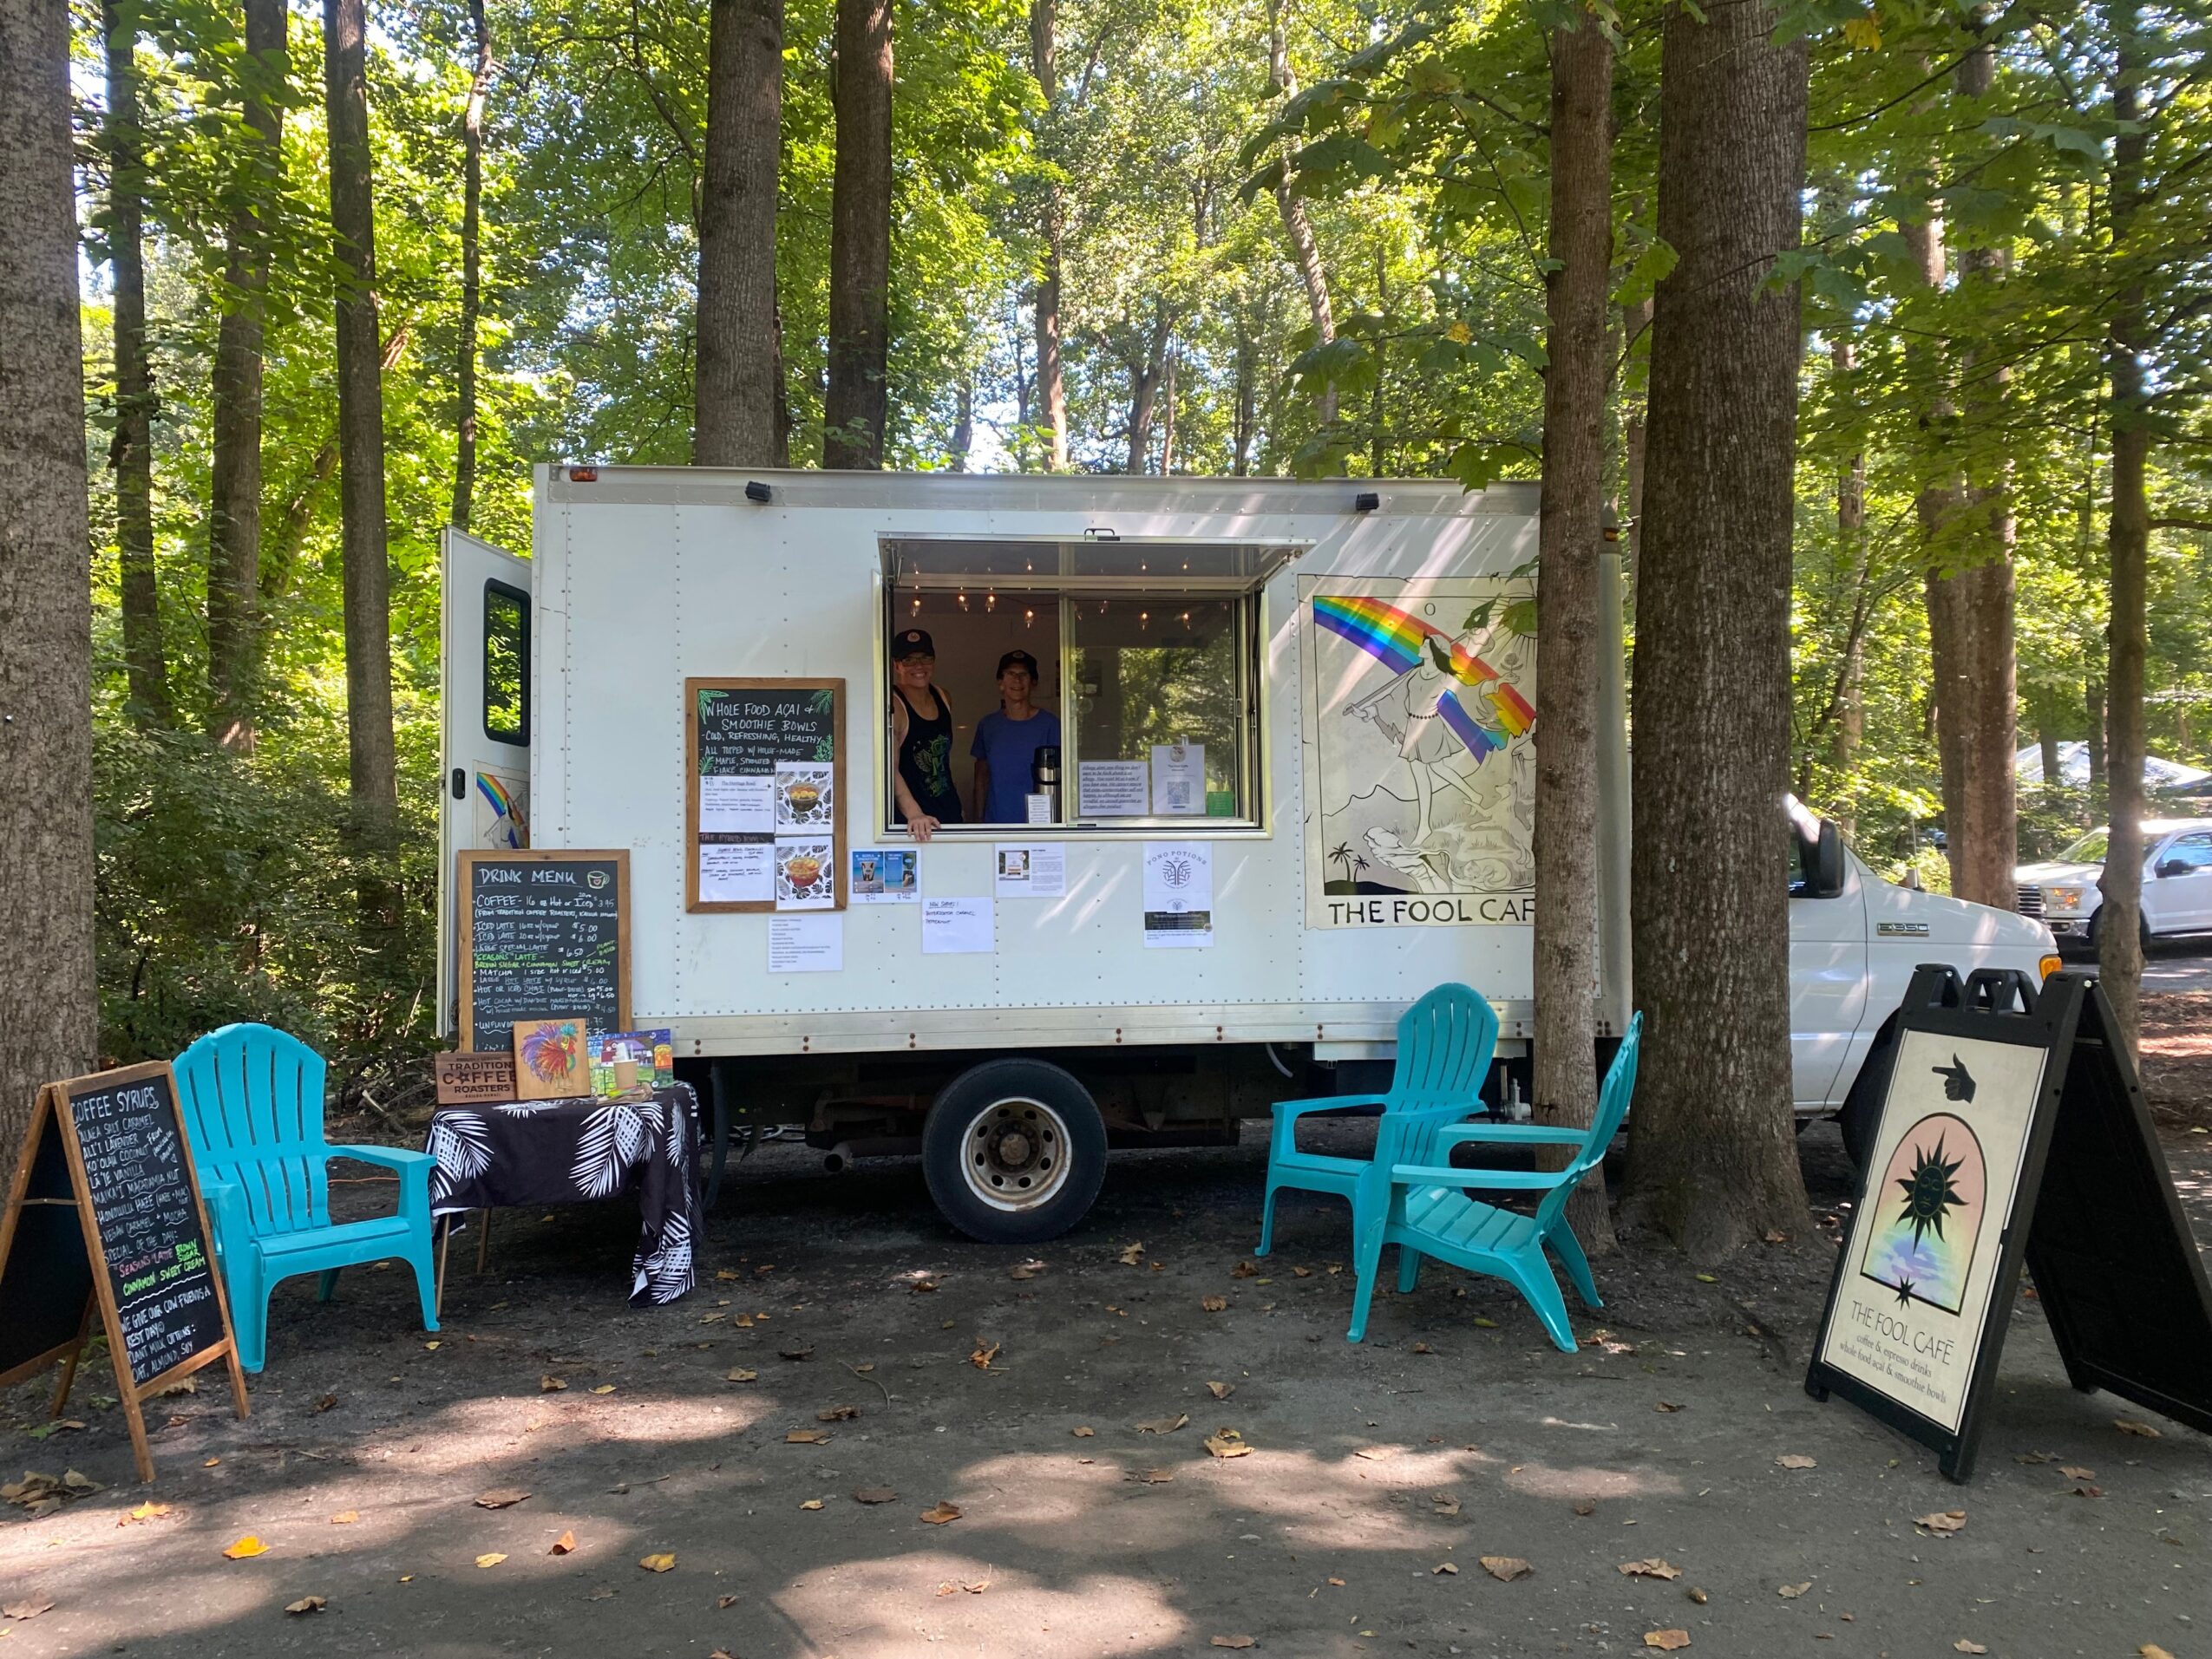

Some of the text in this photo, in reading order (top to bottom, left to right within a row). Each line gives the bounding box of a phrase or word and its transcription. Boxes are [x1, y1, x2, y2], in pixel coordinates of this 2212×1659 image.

[705, 702, 739, 716] WHOLE
[745, 703, 770, 716] FOOD
[722, 718, 817, 732] SMOOTHIE BOWLS
[784, 734, 822, 744] HEALTHY
[1147, 852, 1168, 865] PONO
[1171, 851, 1207, 865] POTIONS
[479, 868, 577, 884] DRINK MENU
[527, 895, 535, 906] 16
[550, 896, 561, 906] Hot
[1328, 898, 1535, 924] THE FOOL CAF
[476, 922, 494, 931] ICED
[496, 922, 515, 931] LATTE
[477, 932, 495, 942] ICED
[448, 1061, 513, 1070] TRADITION
[455, 1084, 510, 1094] ROASTERS
[70, 1087, 154, 1124] COFFEE SYRUPS
[122, 1114, 154, 1131] CARAMEL
[104, 1133, 138, 1152] LAVENDER
[114, 1164, 145, 1181] VANILLA
[167, 1168, 179, 1183] NUT
[126, 1217, 154, 1232] CARAMEL
[163, 1208, 187, 1222] MOCHA
[104, 1244, 133, 1265] SPECIAL
[136, 1238, 144, 1250] OF
[146, 1235, 157, 1247] THE
[123, 1257, 206, 1296] CINNAMON SWEET CREAM
[120, 1316, 132, 1333] WE
[132, 1309, 148, 1329] GIVE
[148, 1305, 162, 1319] OUR
[163, 1296, 178, 1314] COW
[205, 1285, 211, 1297] A
[145, 1323, 159, 1341] DAY
[1851, 1300, 1875, 1329] THE
[1875, 1312, 1908, 1347] FOOL
[126, 1345, 148, 1365] PLANT
[148, 1337, 167, 1354] MILK
[180, 1341, 193, 1355] SOY
[1856, 1335, 1932, 1377] coffee & espresso drinks
[1840, 1341, 1857, 1358] whole
[1857, 1349, 1872, 1365] food
[1886, 1363, 1893, 1376] &
[1895, 1369, 1926, 1393] smoothie
[1927, 1384, 1947, 1404] bowls
